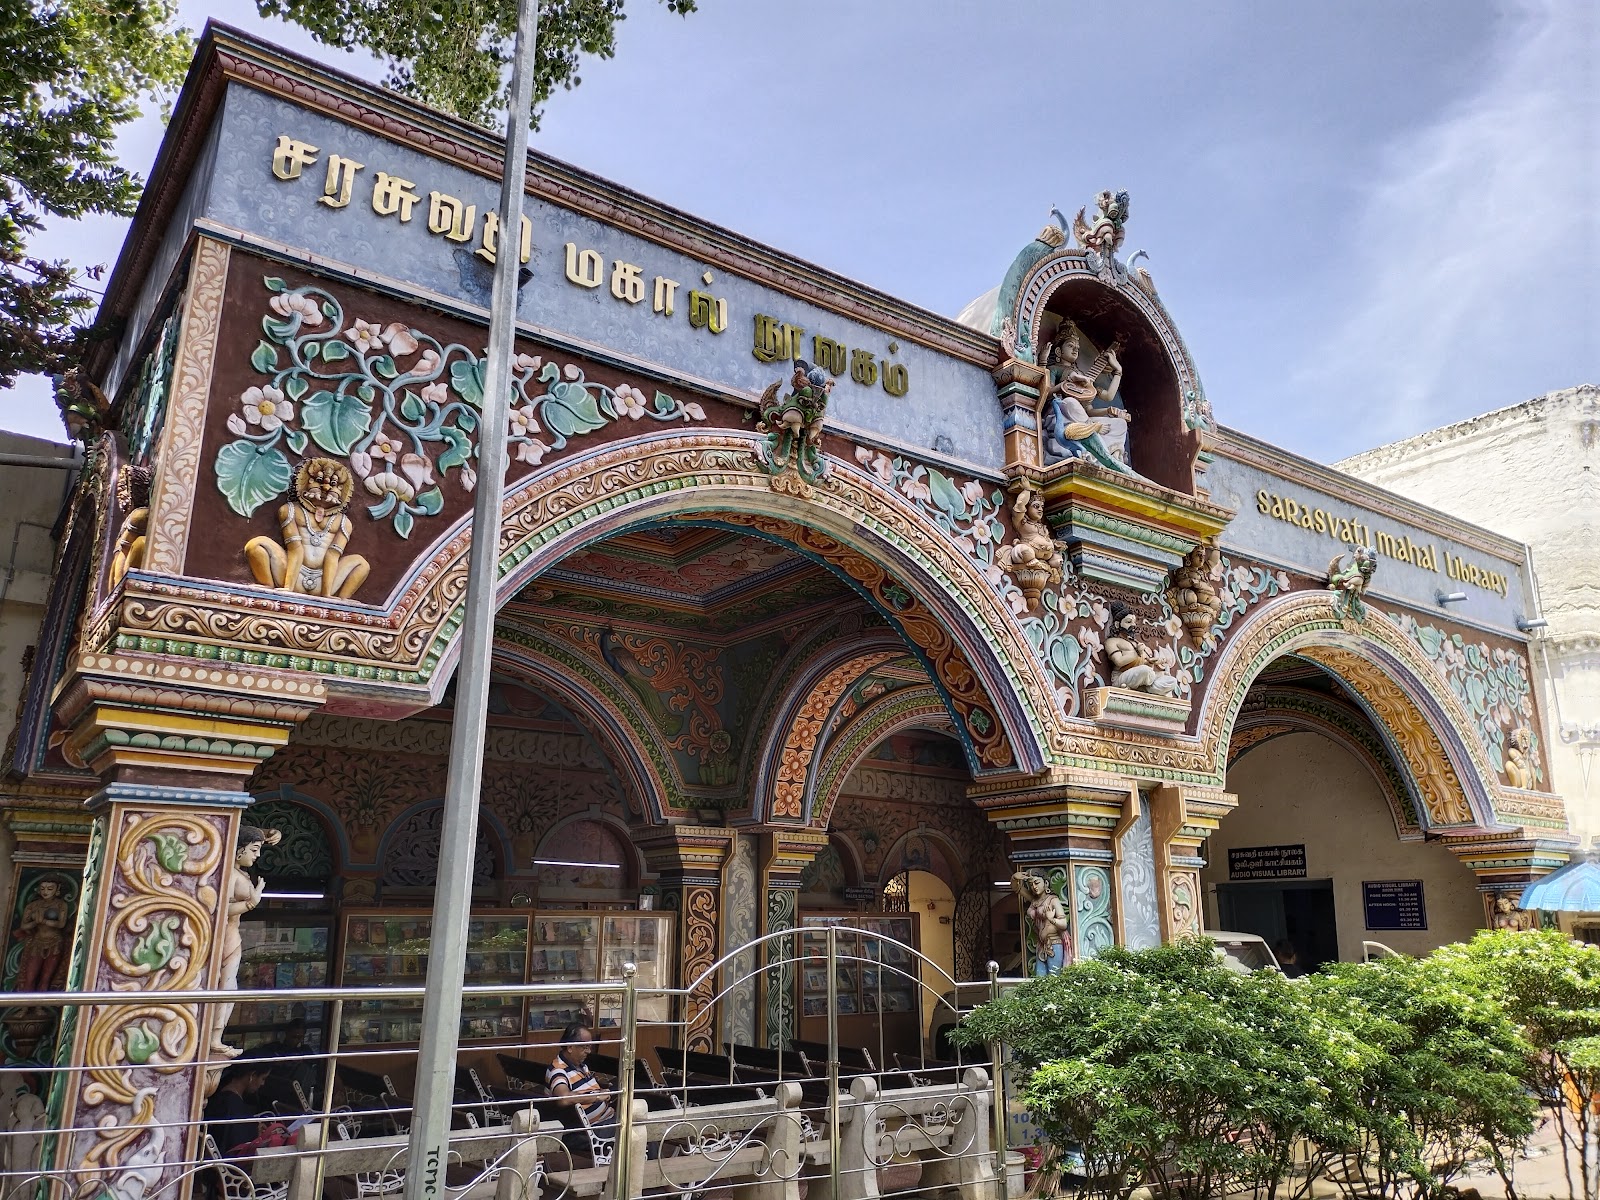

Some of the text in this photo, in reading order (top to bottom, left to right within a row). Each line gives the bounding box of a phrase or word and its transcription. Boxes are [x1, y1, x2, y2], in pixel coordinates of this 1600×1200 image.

[564, 242, 728, 335] மகால்
[752, 313, 909, 397] நூலகம்
[1251, 869, 1276, 877] VISUAL
[1276, 868, 1306, 876] LIBRARY
